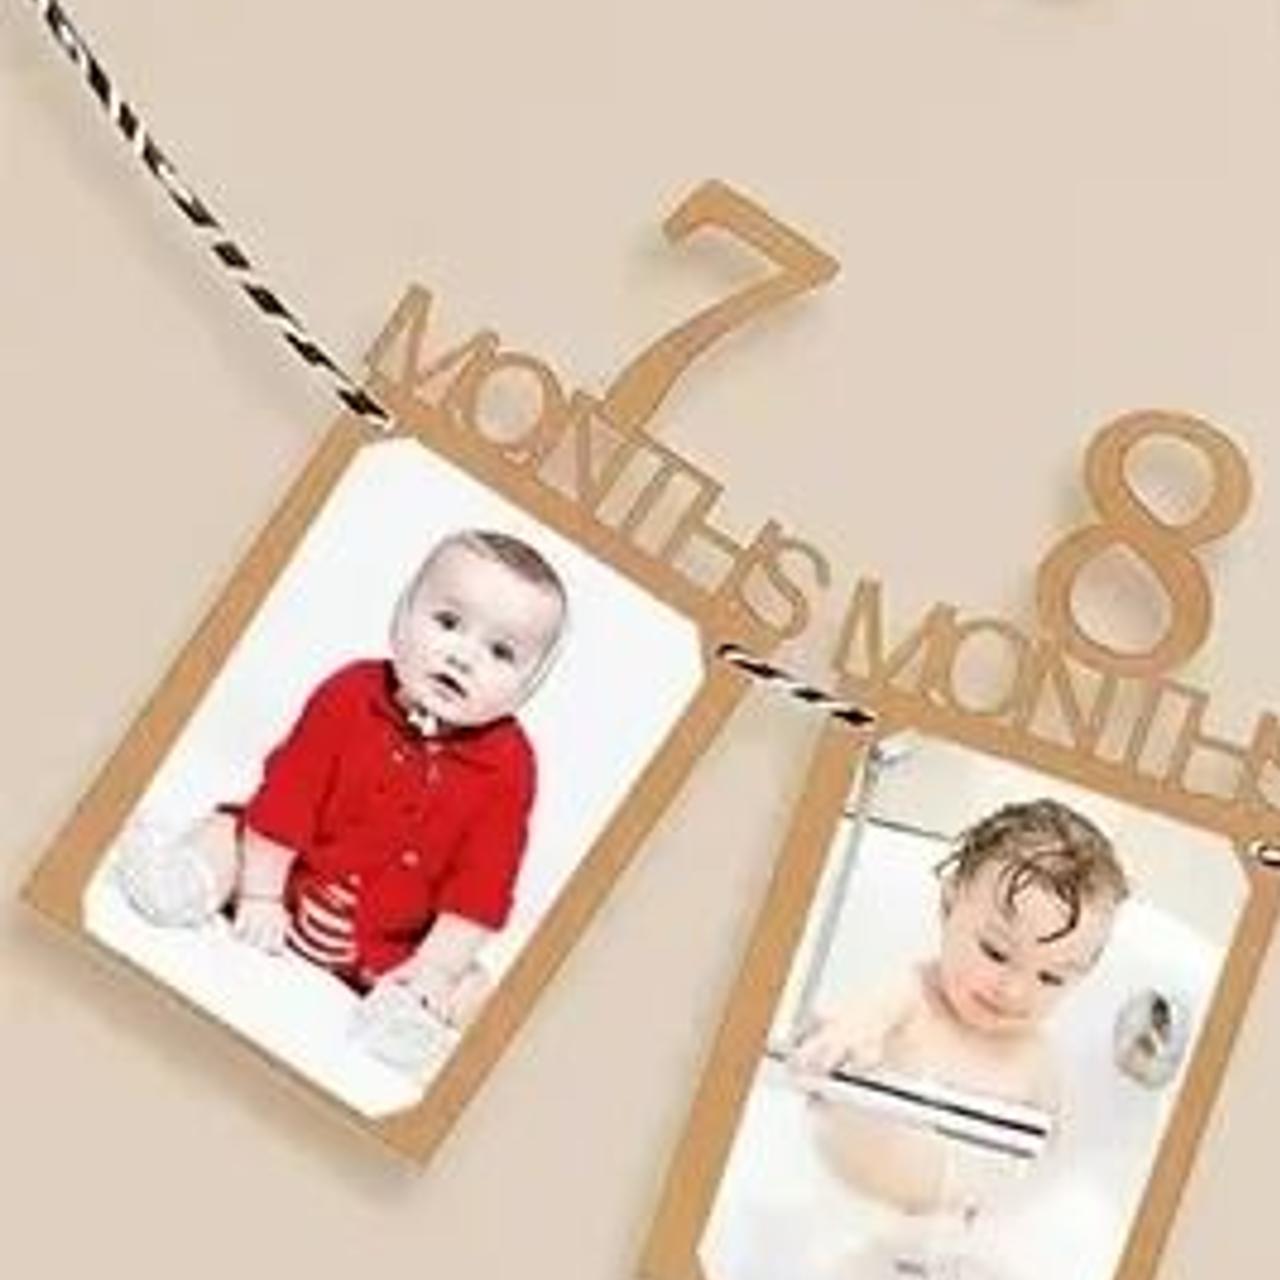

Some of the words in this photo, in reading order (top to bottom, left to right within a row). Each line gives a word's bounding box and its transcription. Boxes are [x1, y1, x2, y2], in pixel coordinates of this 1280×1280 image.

[602, 179, 840, 437] 7
[363, 284, 832, 639] MONTHS
[1036, 409, 1252, 678] 8
